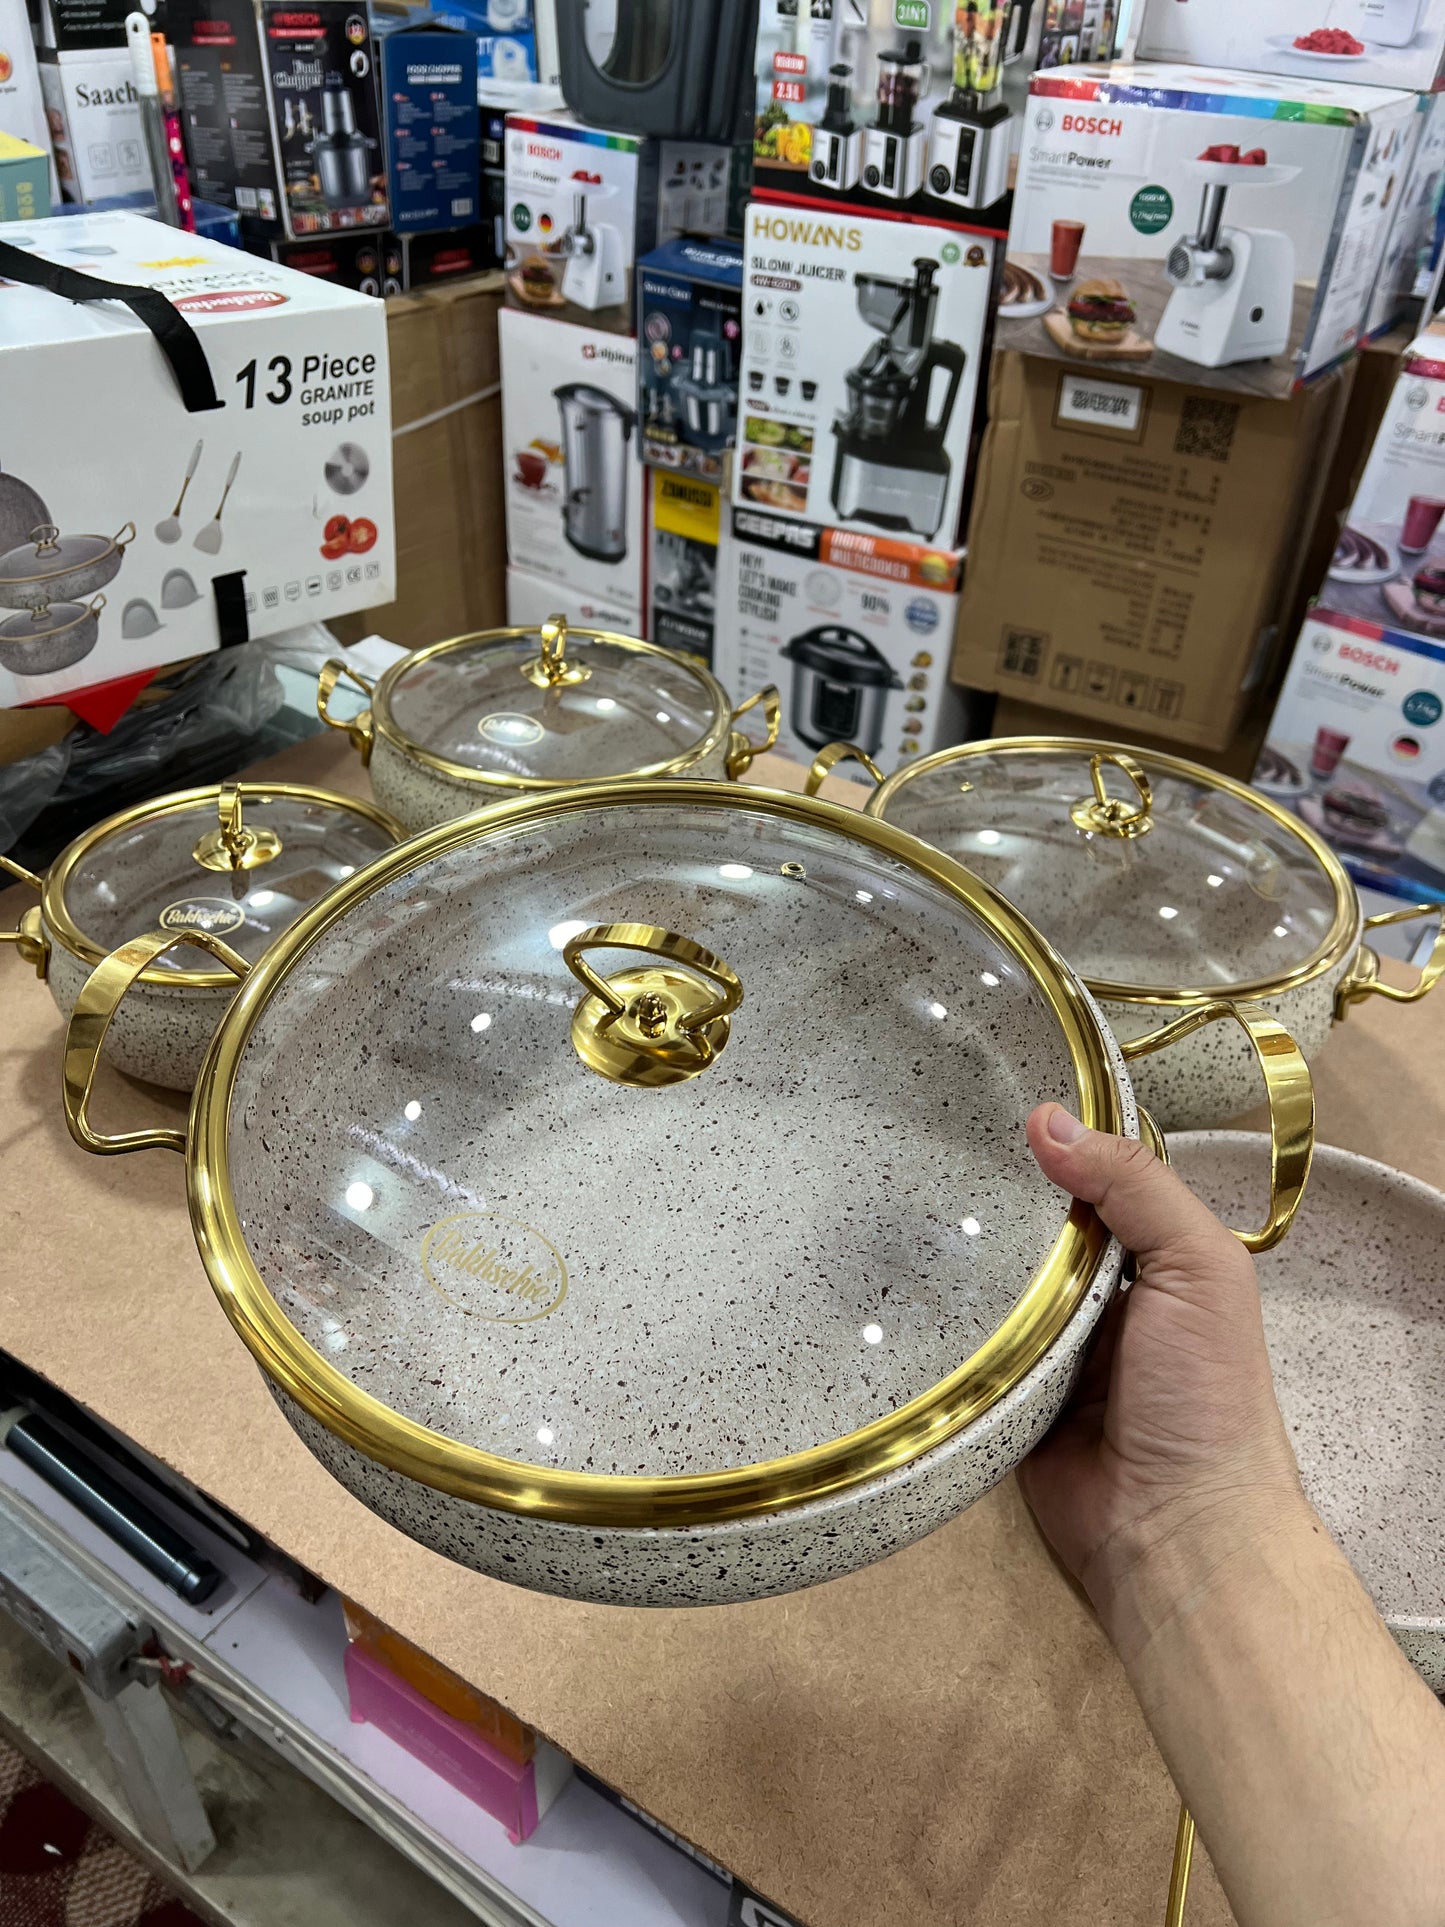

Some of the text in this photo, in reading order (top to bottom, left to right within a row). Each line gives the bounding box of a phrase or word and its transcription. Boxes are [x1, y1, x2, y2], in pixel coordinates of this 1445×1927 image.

[1061, 113, 1123, 138] BOSCH
[526, 143, 562, 162] BOSCH
[1028, 147, 1113, 169] SmartPower
[753, 215, 864, 252] HOWANS
[751, 256, 793, 273] SLOW
[794, 262, 847, 281] JUICER
[236, 353, 376, 410] 13 Piece
[300, 379, 375, 406] GRANITE
[302, 400, 375, 427] soup pot
[735, 511, 816, 549] GEEPAS
[828, 547, 911, 580] MULTICOOKER
[1338, 643, 1401, 676] BOSCH
